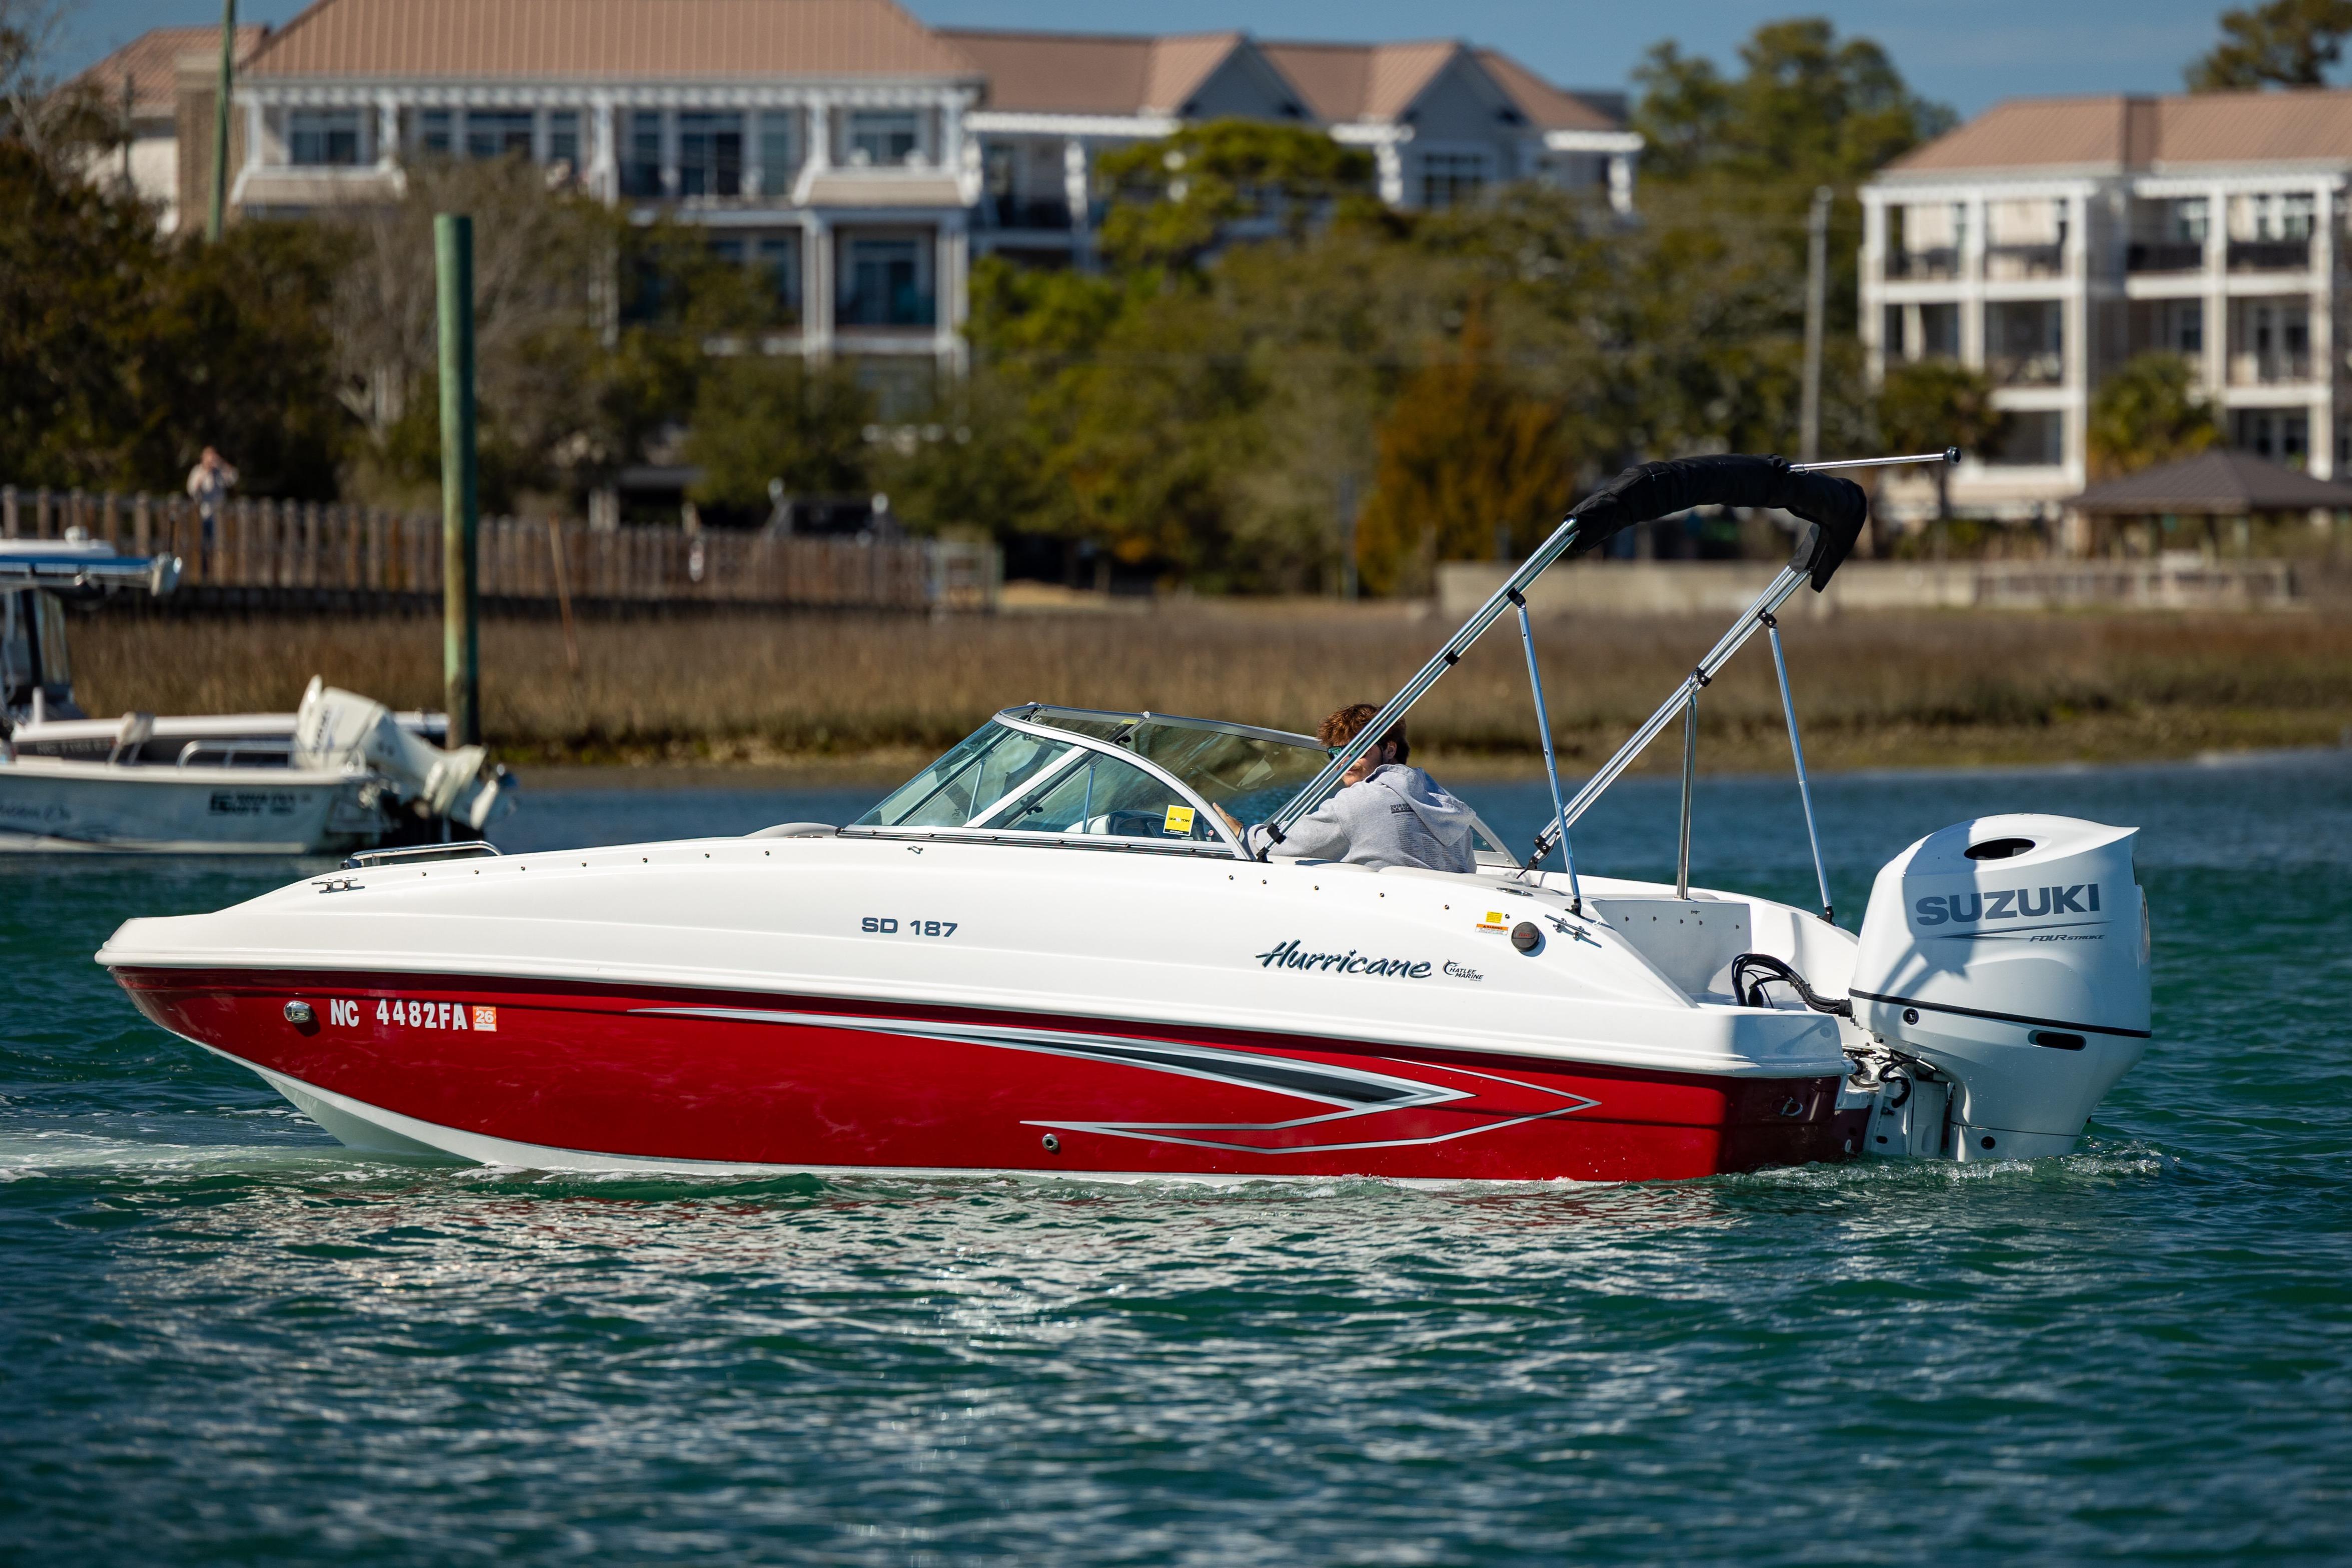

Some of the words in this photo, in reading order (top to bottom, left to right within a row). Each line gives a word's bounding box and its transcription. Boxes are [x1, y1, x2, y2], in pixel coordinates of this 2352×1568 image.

[1916, 884, 2100, 926] SUZUKI
[861, 917, 898, 933] SD
[909, 920, 958, 937] 187
[1254, 939, 1432, 979] Hurricane
[330, 999, 360, 1027] NC
[376, 999, 468, 1030] 4482FA
[475, 1010, 494, 1023] 26
